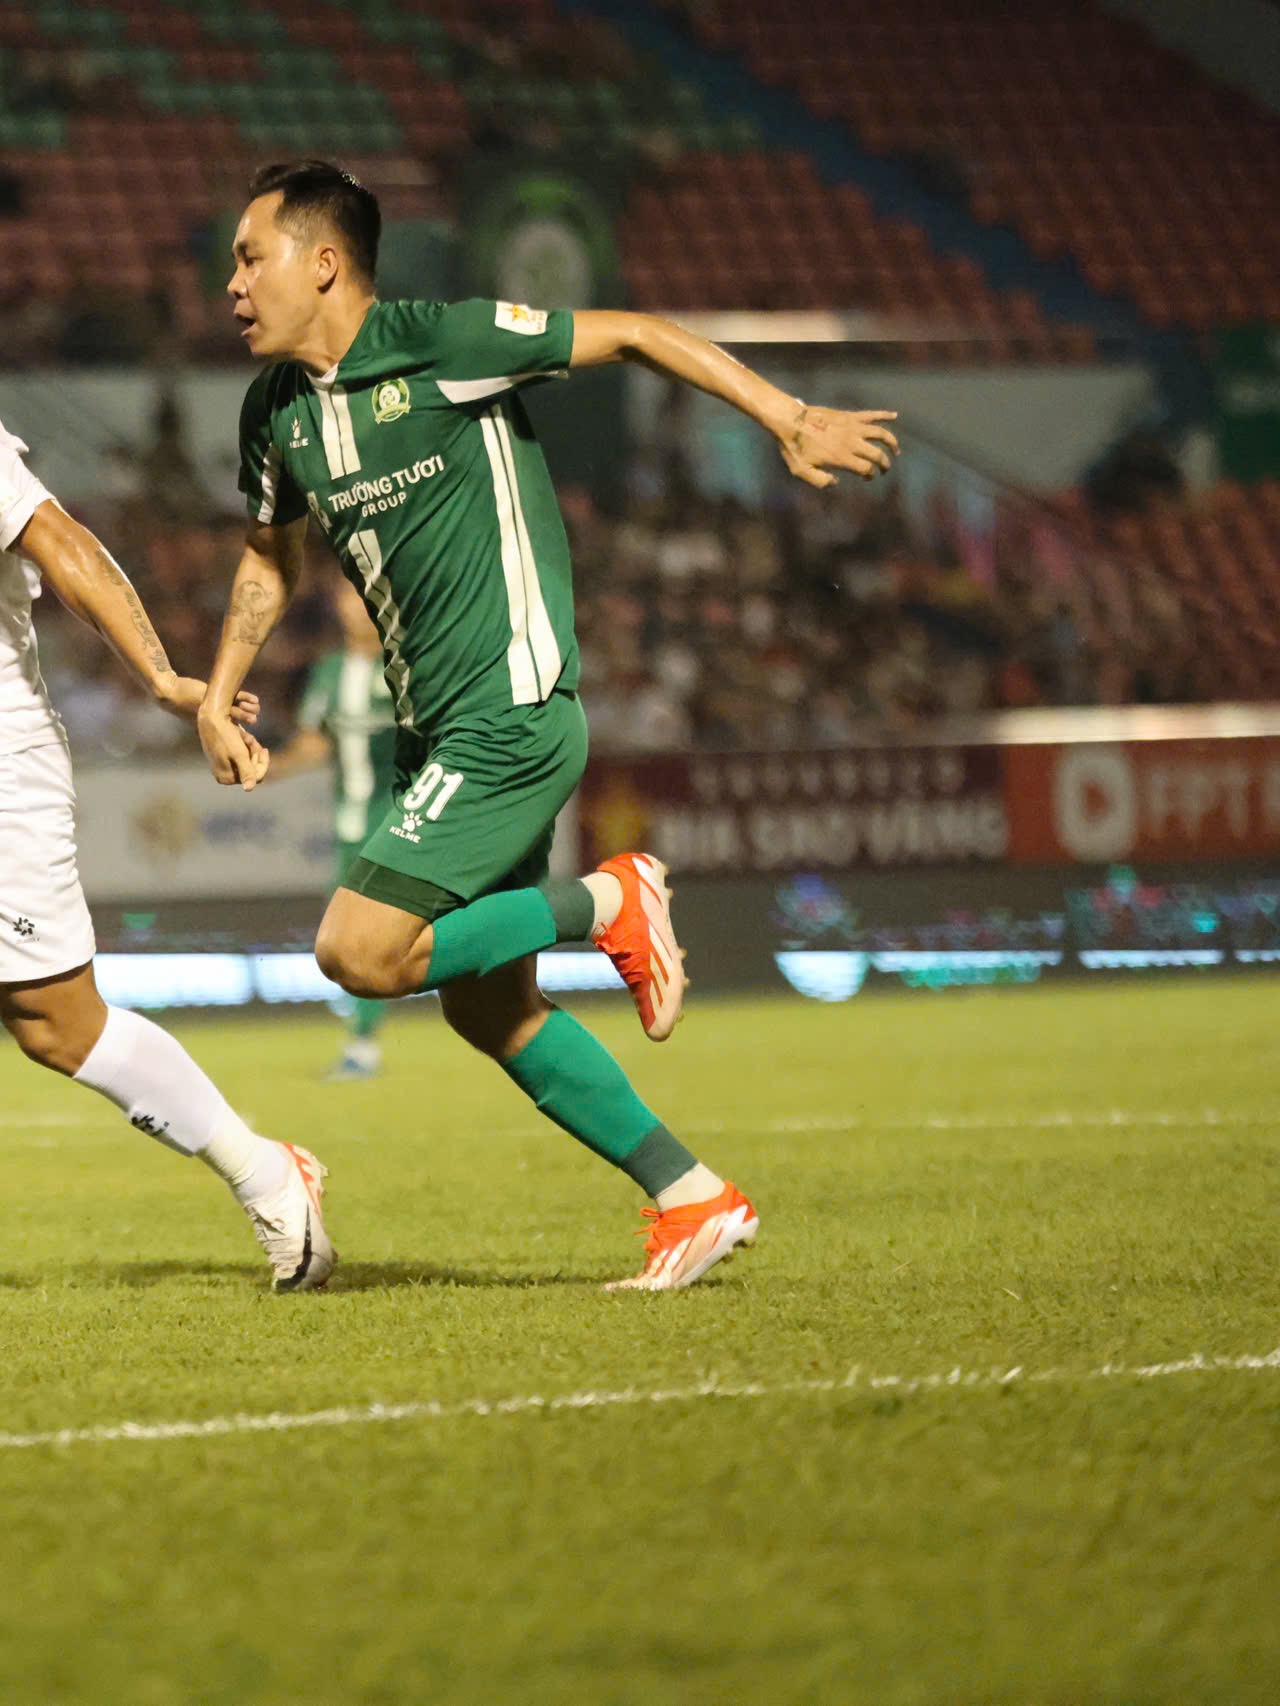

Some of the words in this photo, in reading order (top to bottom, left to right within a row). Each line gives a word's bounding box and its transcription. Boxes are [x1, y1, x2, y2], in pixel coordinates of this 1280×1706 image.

[327, 476, 394, 513] TRƯỜNG
[392, 454, 445, 489] TƯƠI
[361, 491, 408, 518] GROUP
[403, 762, 464, 821] 91
[389, 826, 422, 844] KELME
